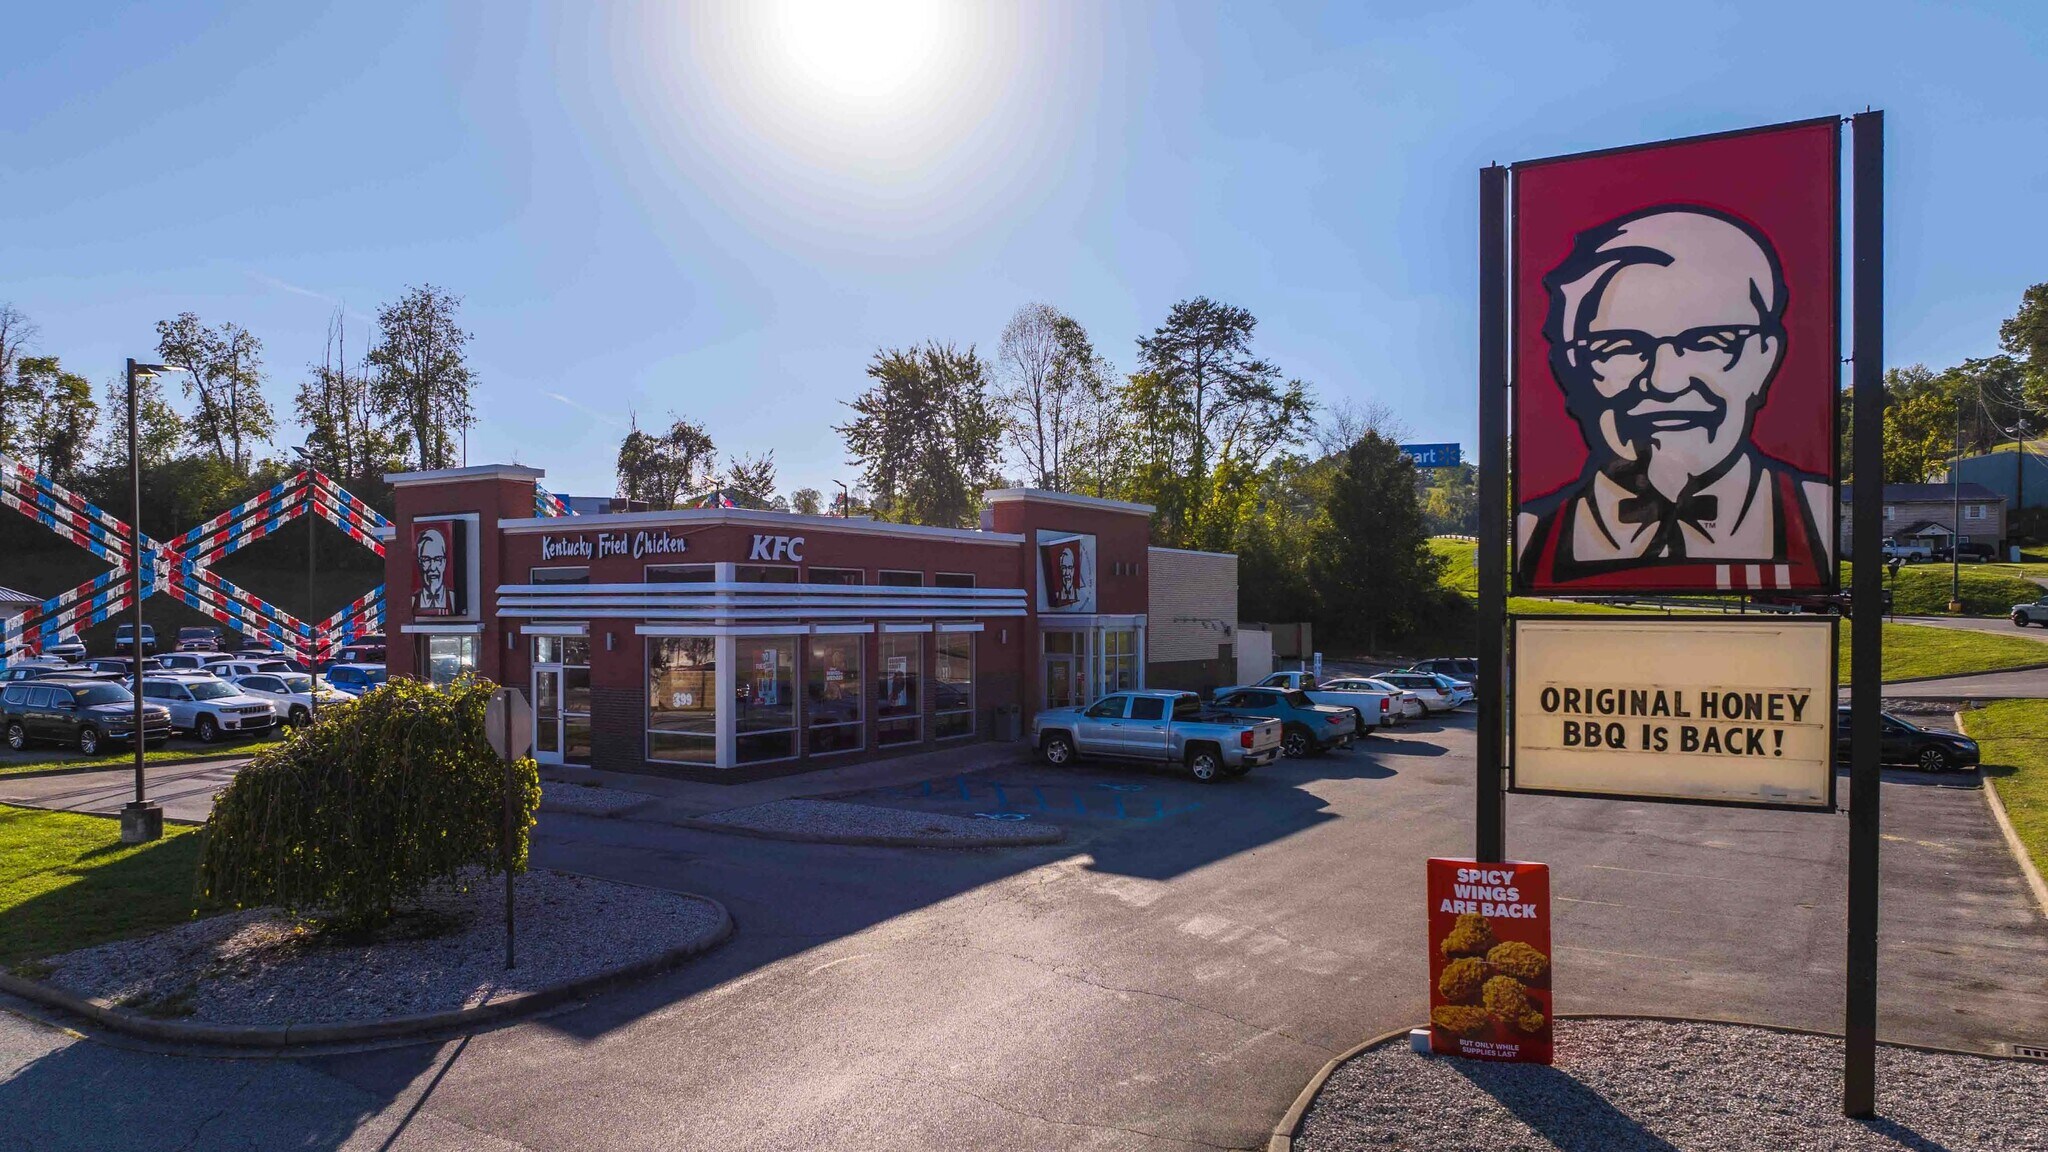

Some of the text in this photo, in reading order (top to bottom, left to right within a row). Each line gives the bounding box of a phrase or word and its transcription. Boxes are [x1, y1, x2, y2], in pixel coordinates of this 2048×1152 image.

[542, 531, 686, 560] Kentucky Fried Chicken
[750, 535, 804, 562] KFC
[1540, 687, 1809, 722] ORIGINAL HONEY
[1563, 721, 1784, 757] BBQ IS BACK!
[1457, 868, 1514, 885] SPICY
[1453, 884, 1520, 902] WINGS
[1440, 898, 1537, 918] ARE BACK
[1459, 1038, 1520, 1051] BUT ONLY WHILE
[1462, 1047, 1496, 1056] SUPPLIES
